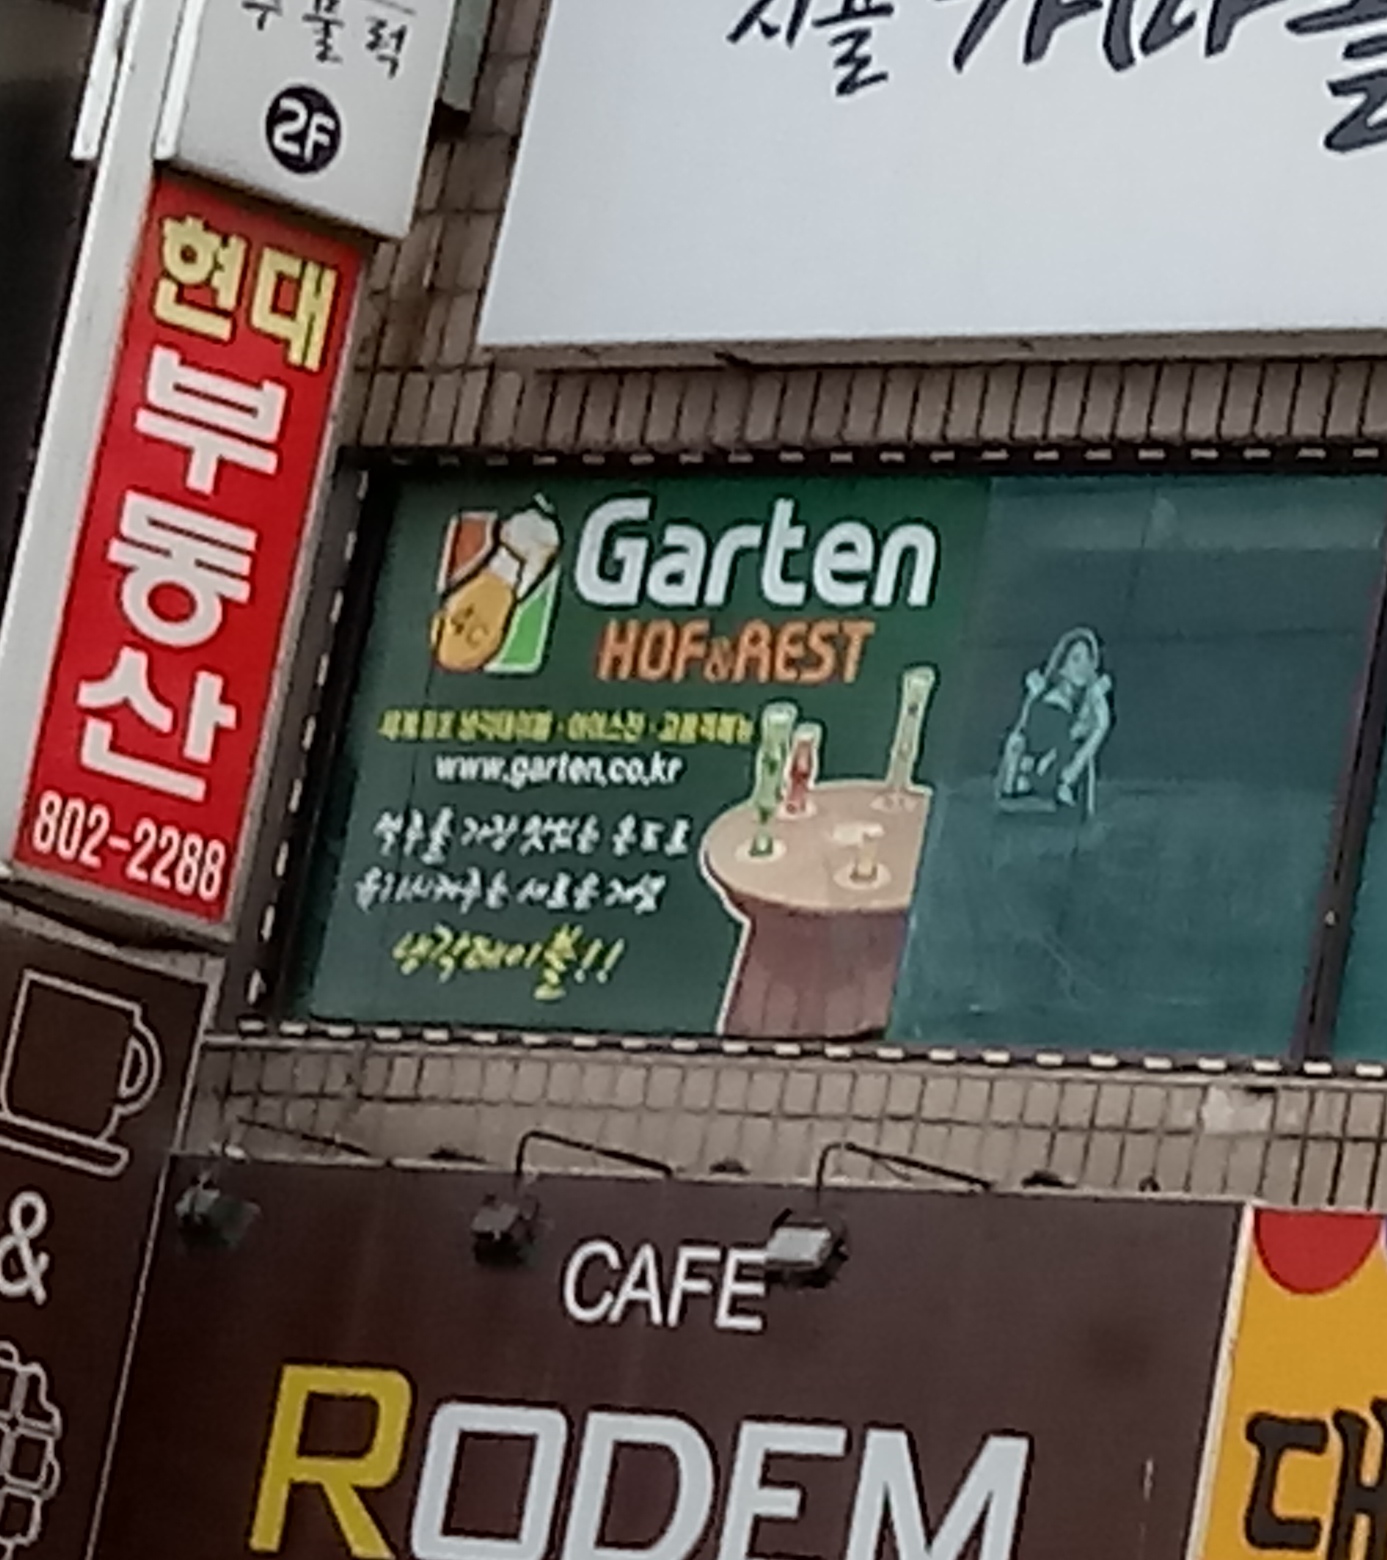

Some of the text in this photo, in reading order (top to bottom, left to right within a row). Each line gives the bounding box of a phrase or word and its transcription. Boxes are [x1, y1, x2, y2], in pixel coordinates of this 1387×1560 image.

[269, 92, 339, 168] 2F
[152, 211, 341, 375] 현대
[75, 345, 289, 803] 부동산
[573, 495, 939, 608] Garten
[435, 750, 684, 790] www.garten.co.kr
[31, 790, 228, 904] 802-2288
[562, 1238, 770, 1333] CAFE
